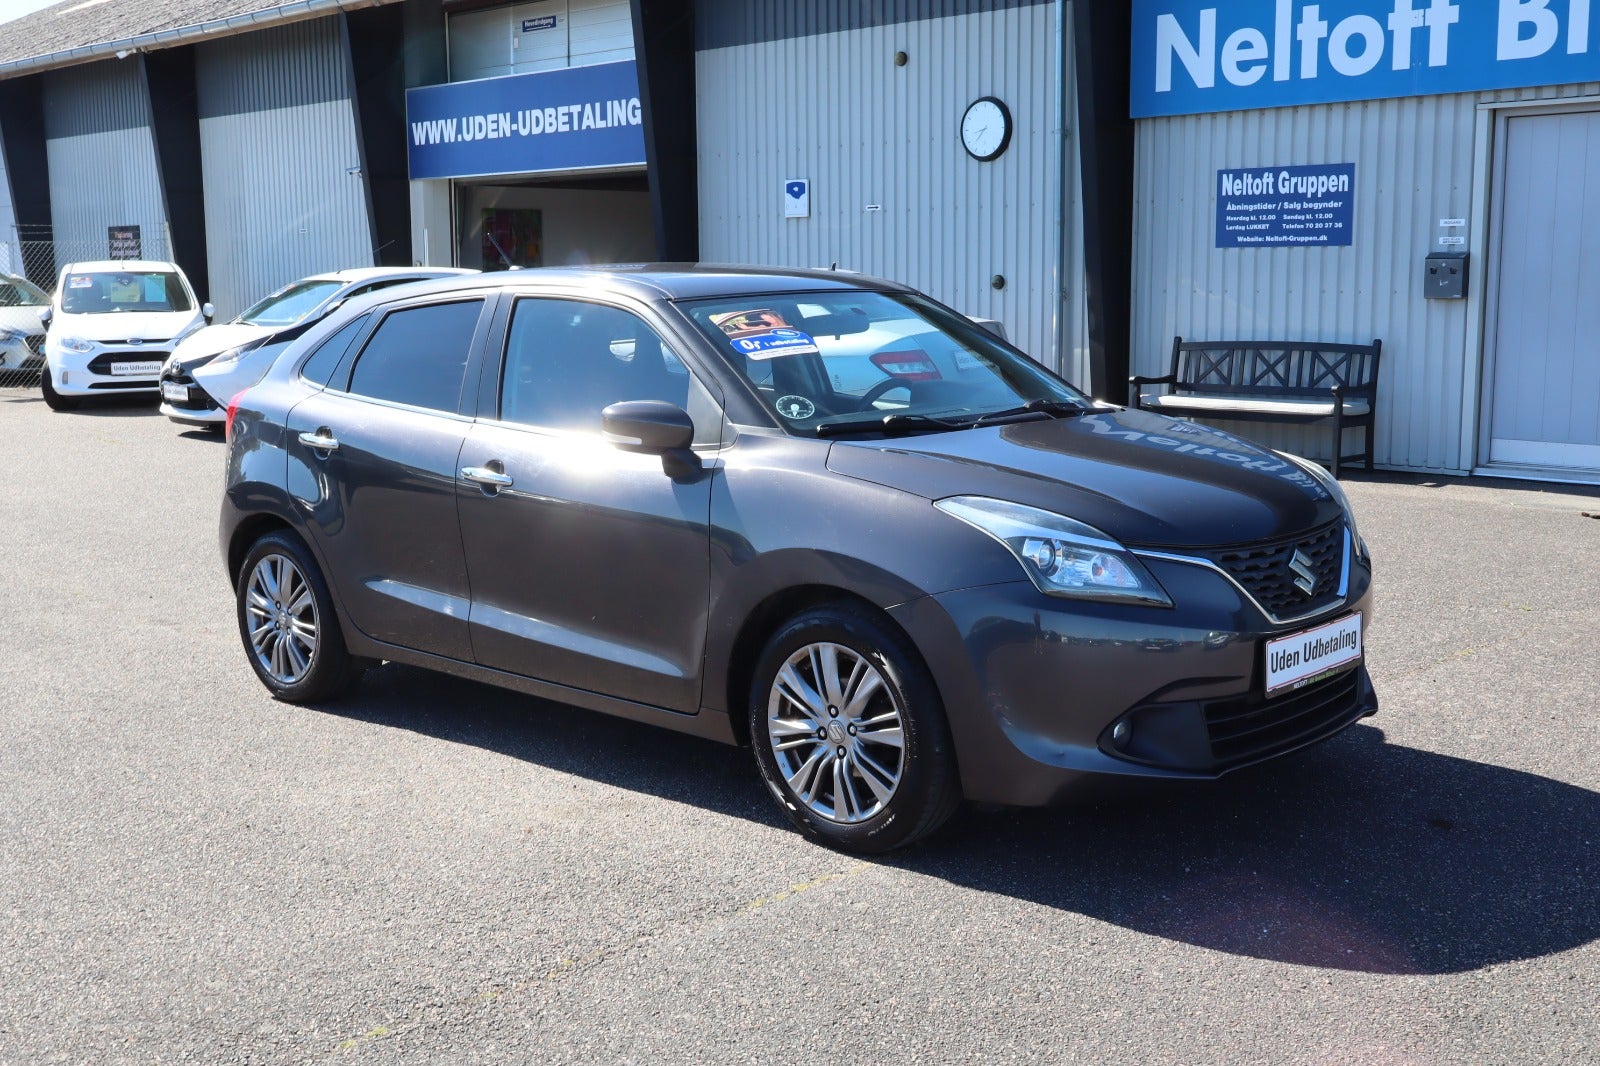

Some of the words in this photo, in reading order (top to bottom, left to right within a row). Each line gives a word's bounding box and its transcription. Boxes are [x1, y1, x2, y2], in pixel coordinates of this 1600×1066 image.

[1155, 0, 1459, 92] Neltoft
[1222, 172, 1274, 196] Neltoft
[1278, 170, 1349, 198] Gruppen
[1303, 200, 1343, 210] begynder
[1270, 648, 1300, 674] Uden
[1303, 629, 1357, 663] Udbetaling
